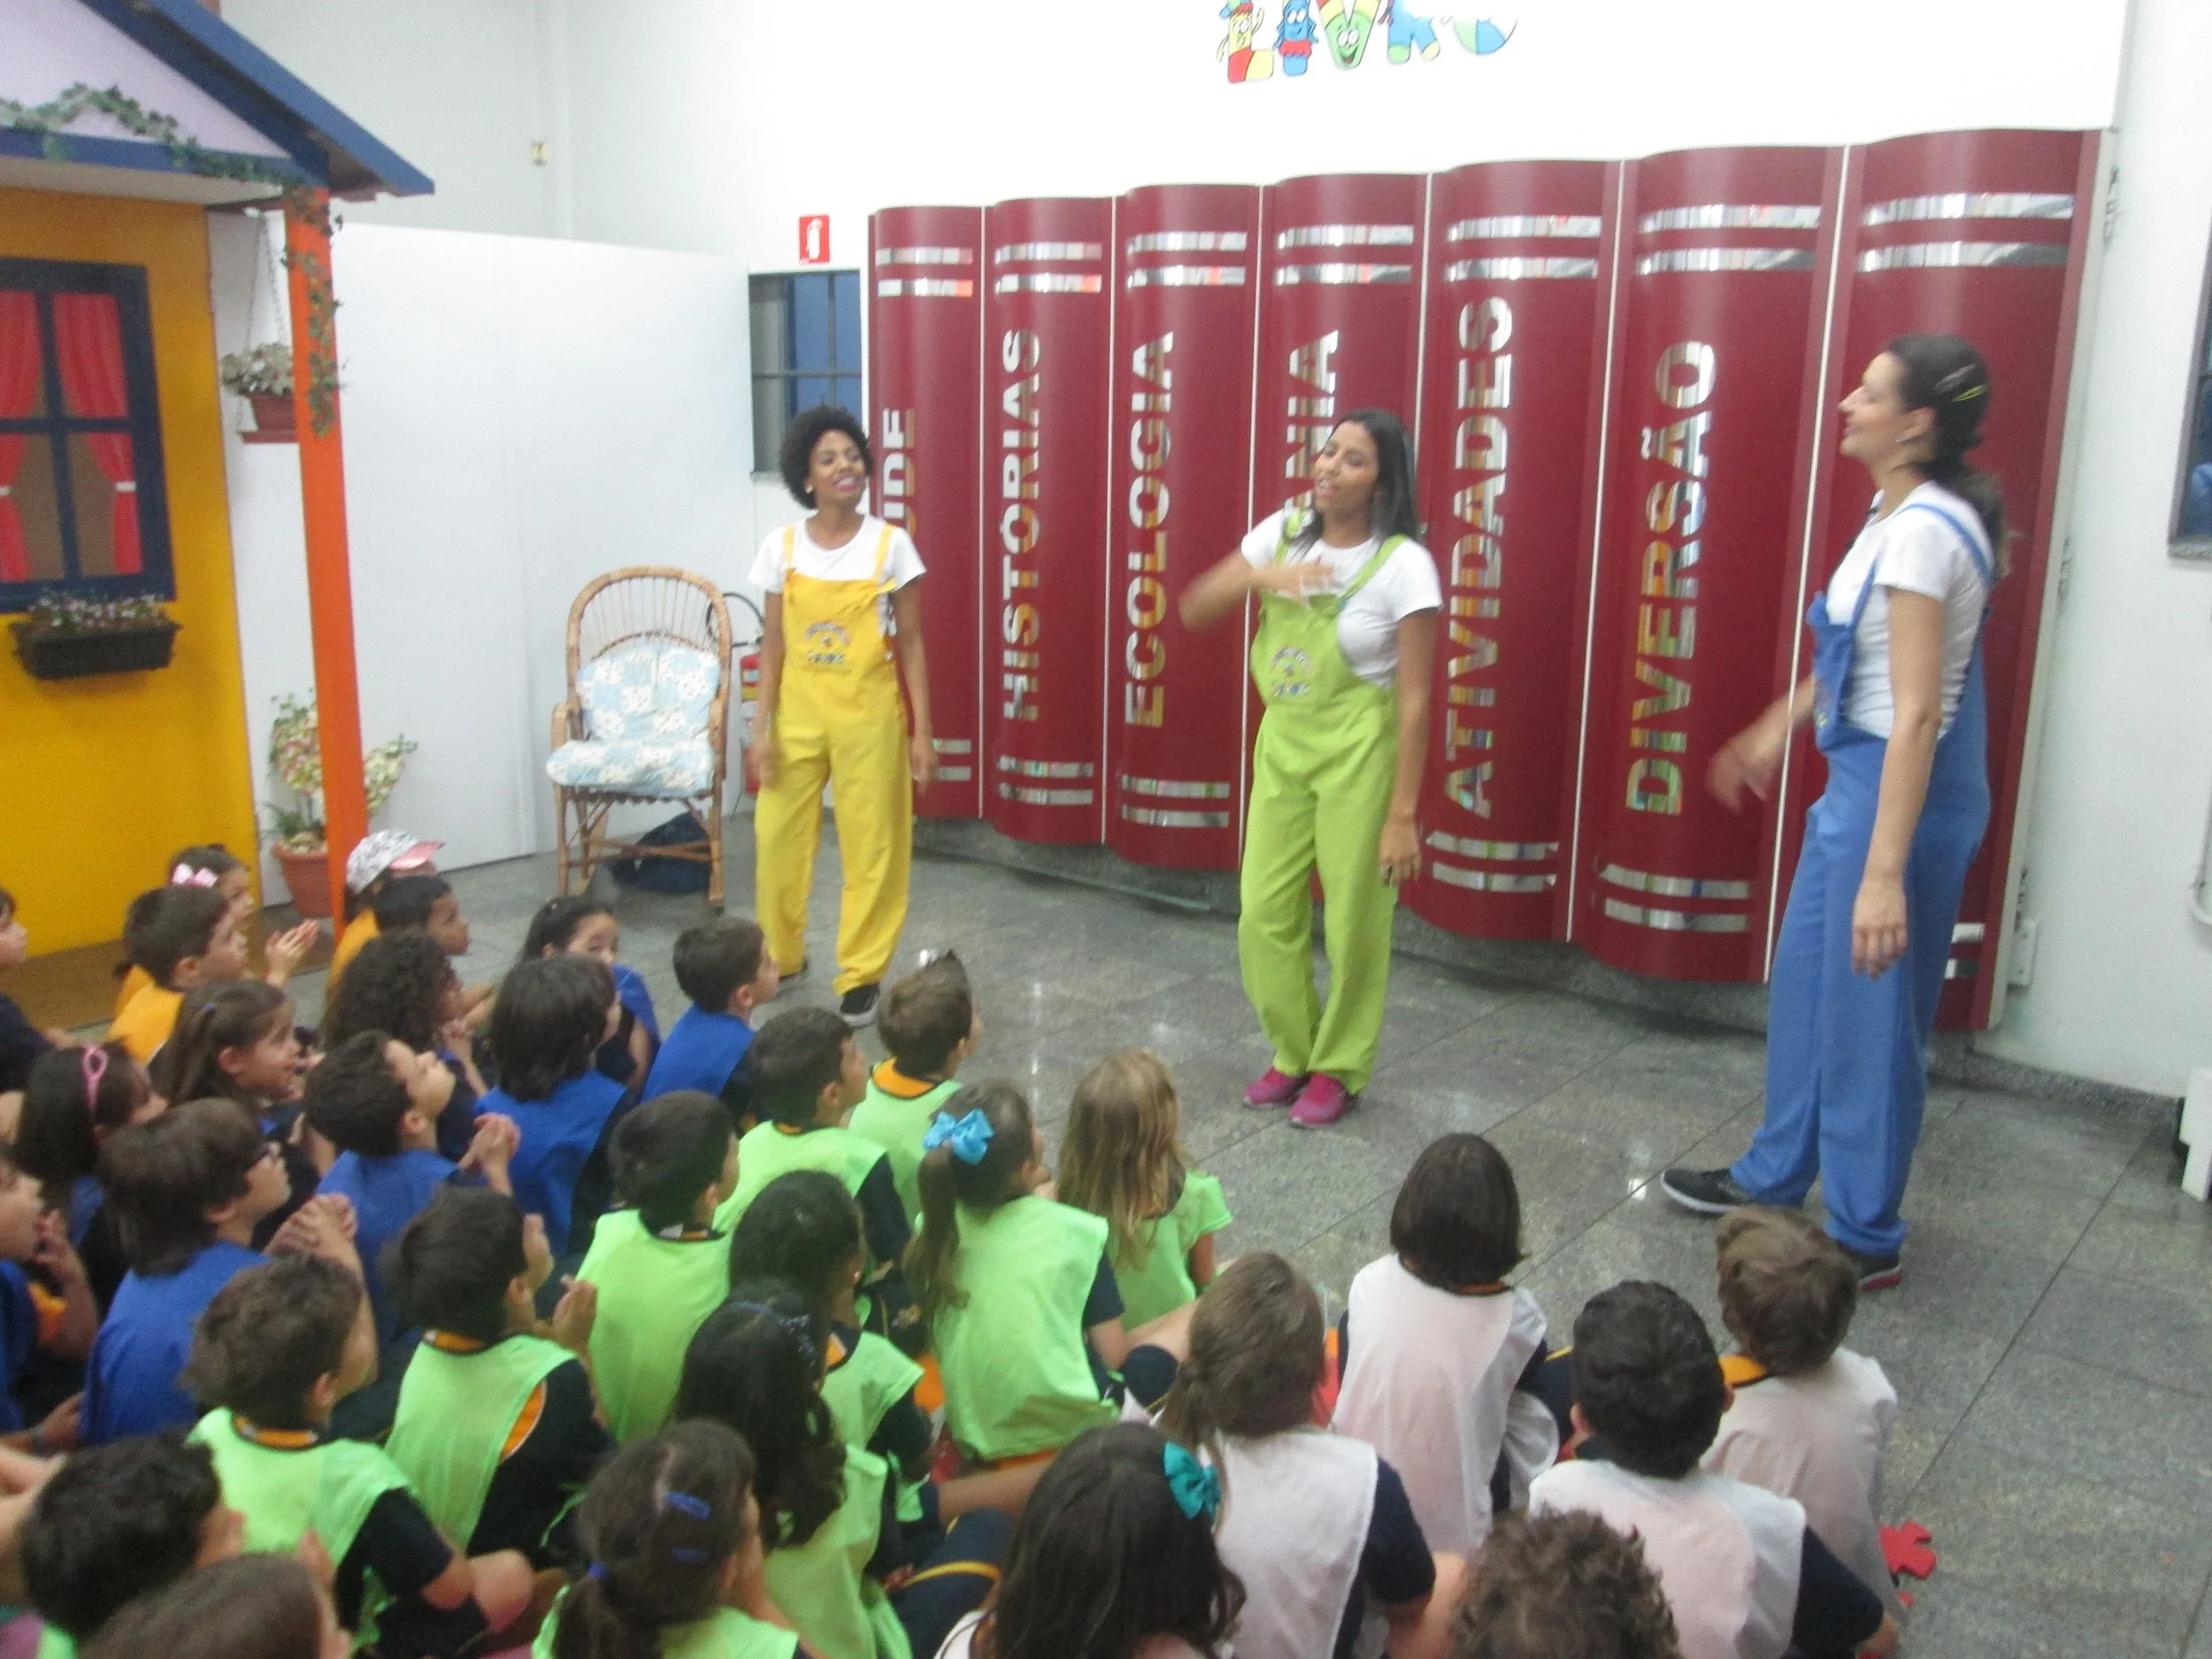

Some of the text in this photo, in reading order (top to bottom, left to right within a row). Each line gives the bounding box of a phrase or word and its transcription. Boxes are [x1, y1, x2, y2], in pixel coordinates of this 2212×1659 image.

[1002, 329, 1040, 720] HISTORIAS
[1125, 332, 1174, 728] ECOLOGIA
[1444, 296, 1512, 818] ATIVIDADES
[1625, 340, 1716, 815] DIVERSÃO
